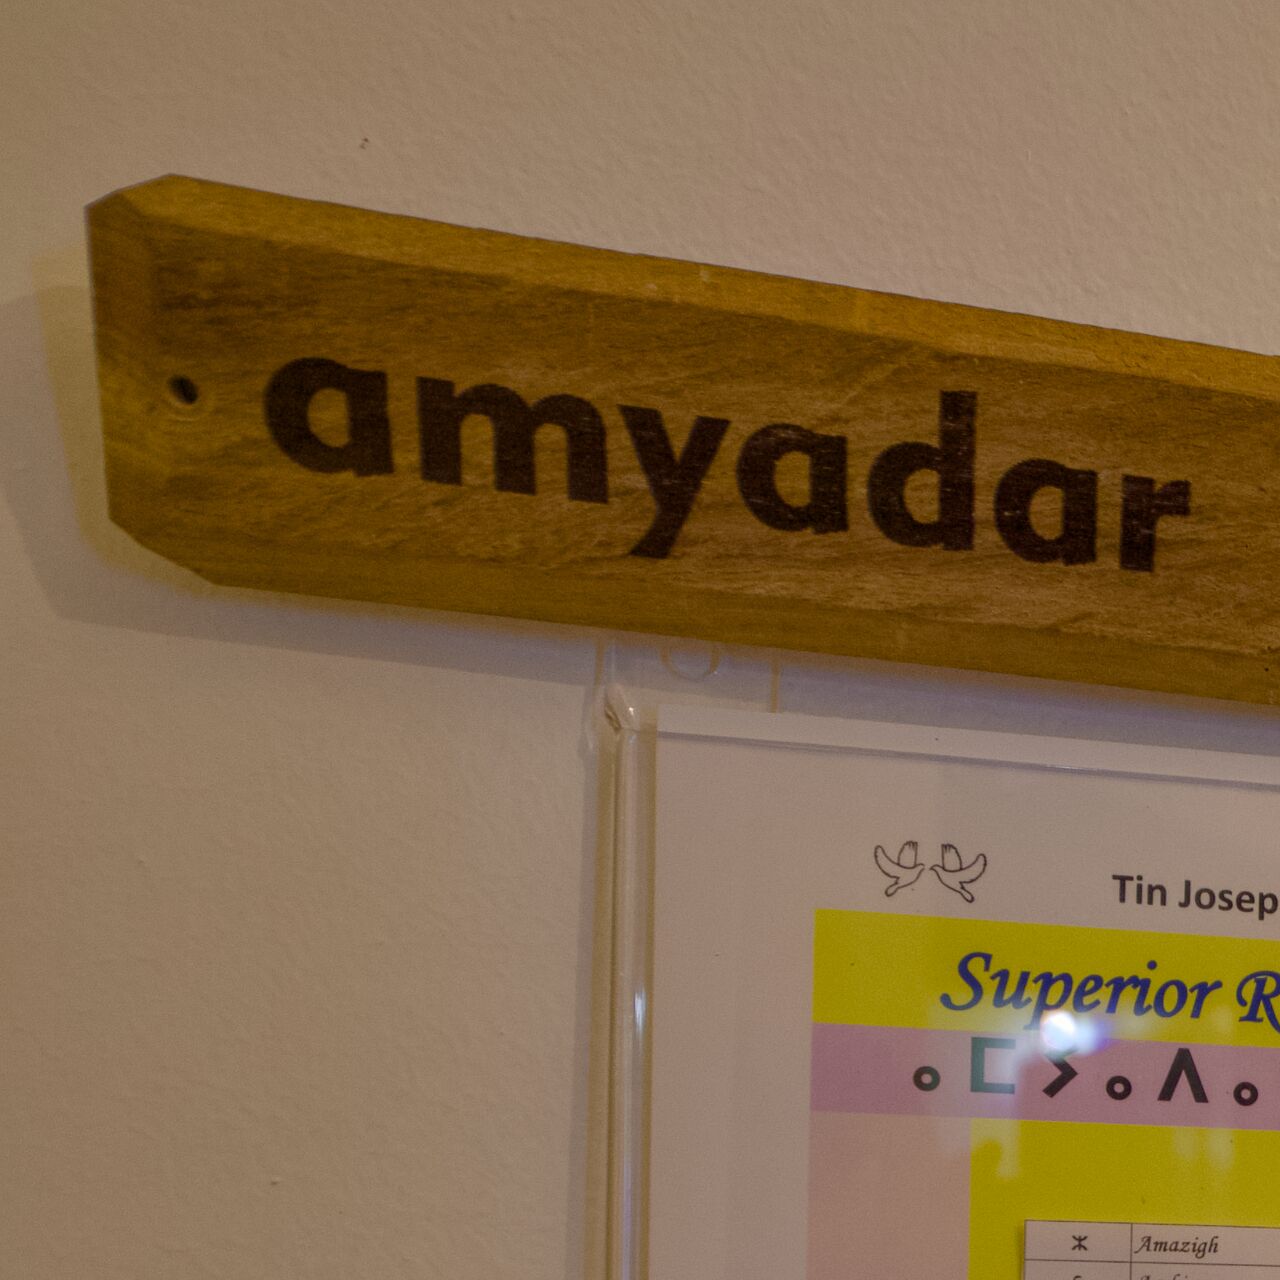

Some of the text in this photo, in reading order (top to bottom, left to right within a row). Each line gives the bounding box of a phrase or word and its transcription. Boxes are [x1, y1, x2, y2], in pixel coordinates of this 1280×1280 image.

[263, 356, 1191, 574] amyadar
[1112, 875, 1166, 906] Tin
[940, 952, 1223, 1031] Superior
[1134, 1236, 1218, 1259] Amazigh
